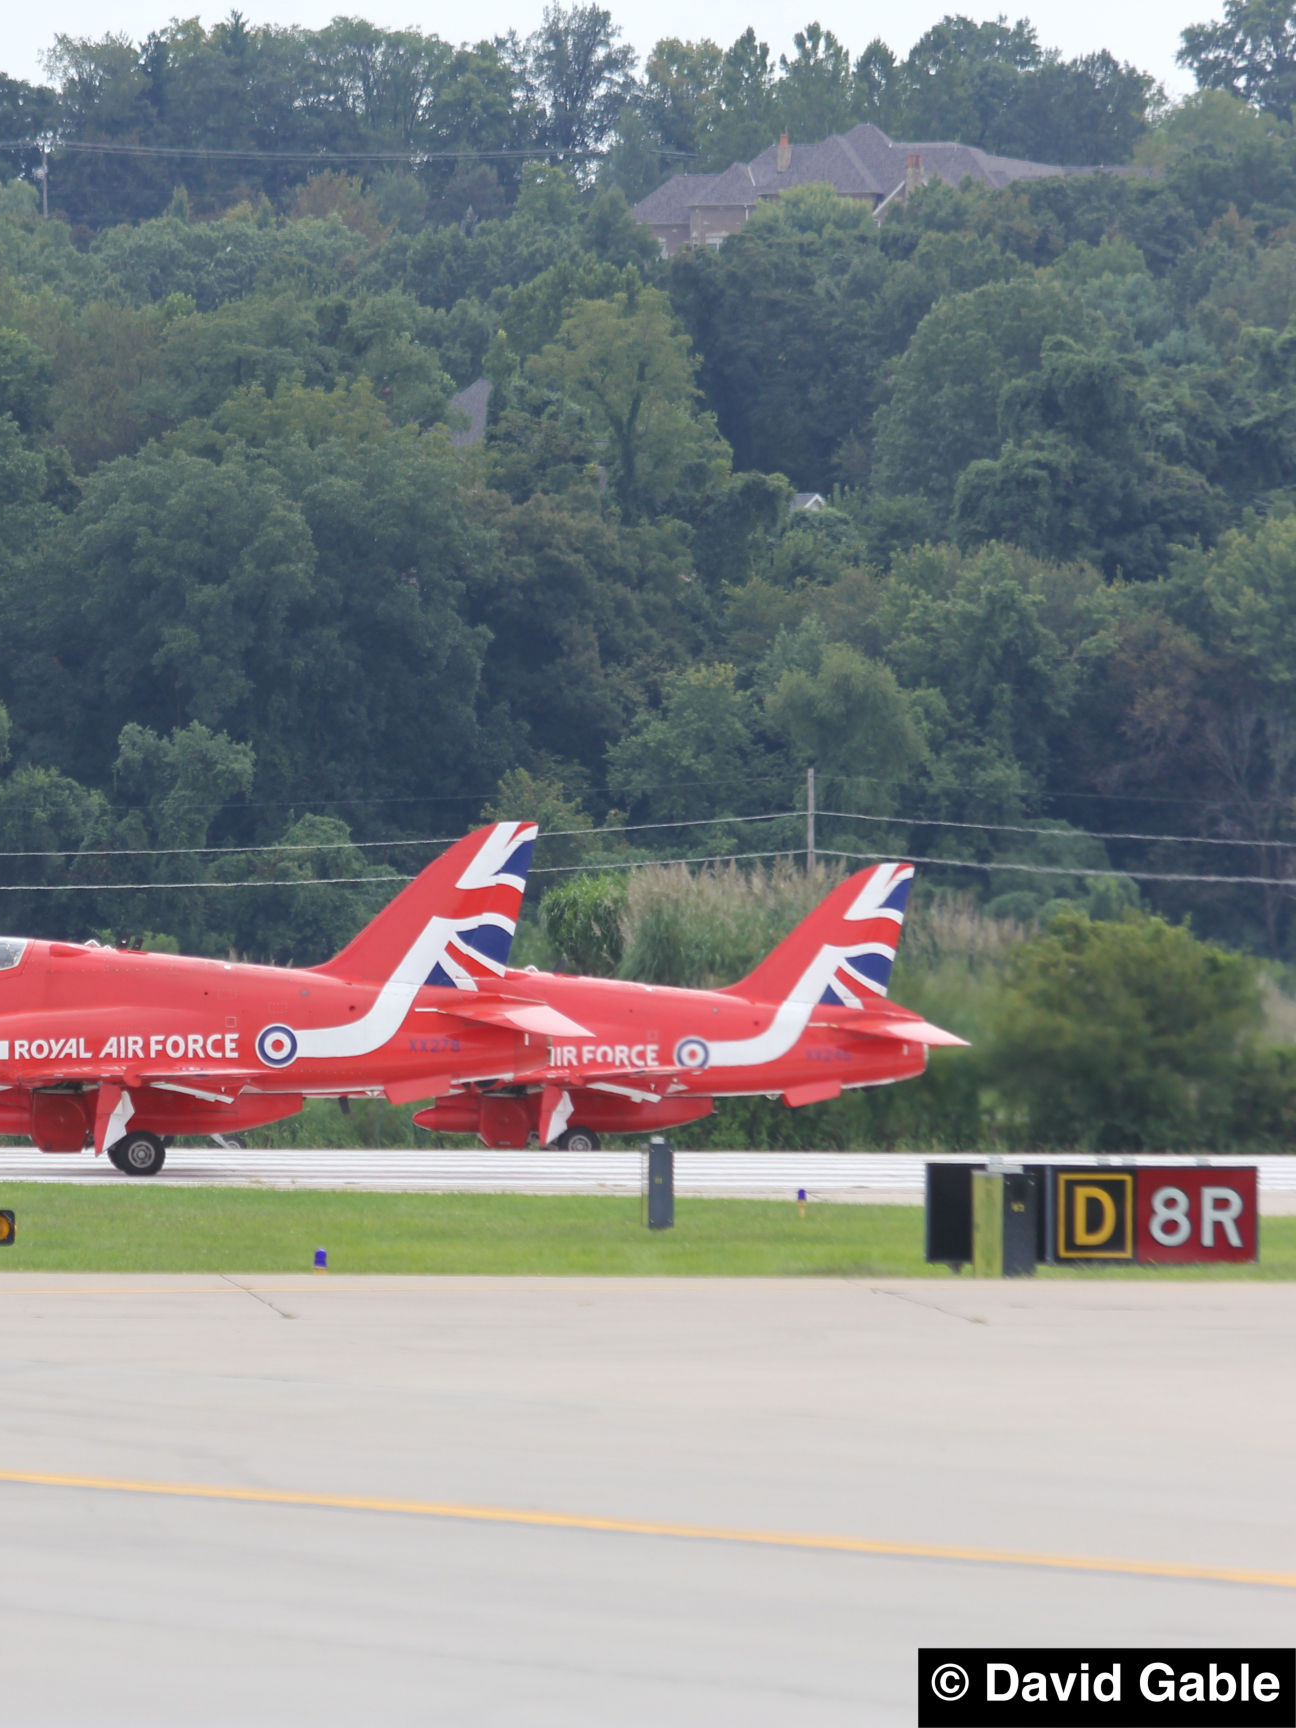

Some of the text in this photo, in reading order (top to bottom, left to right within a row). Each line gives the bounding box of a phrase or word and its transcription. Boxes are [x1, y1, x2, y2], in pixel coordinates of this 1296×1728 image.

[14, 1033, 239, 1059] ROYAL AIR FORCE
[582, 1044, 659, 1067] FORCE
[1073, 1186, 1116, 1246] D
[1149, 1186, 1243, 1248] 8R
